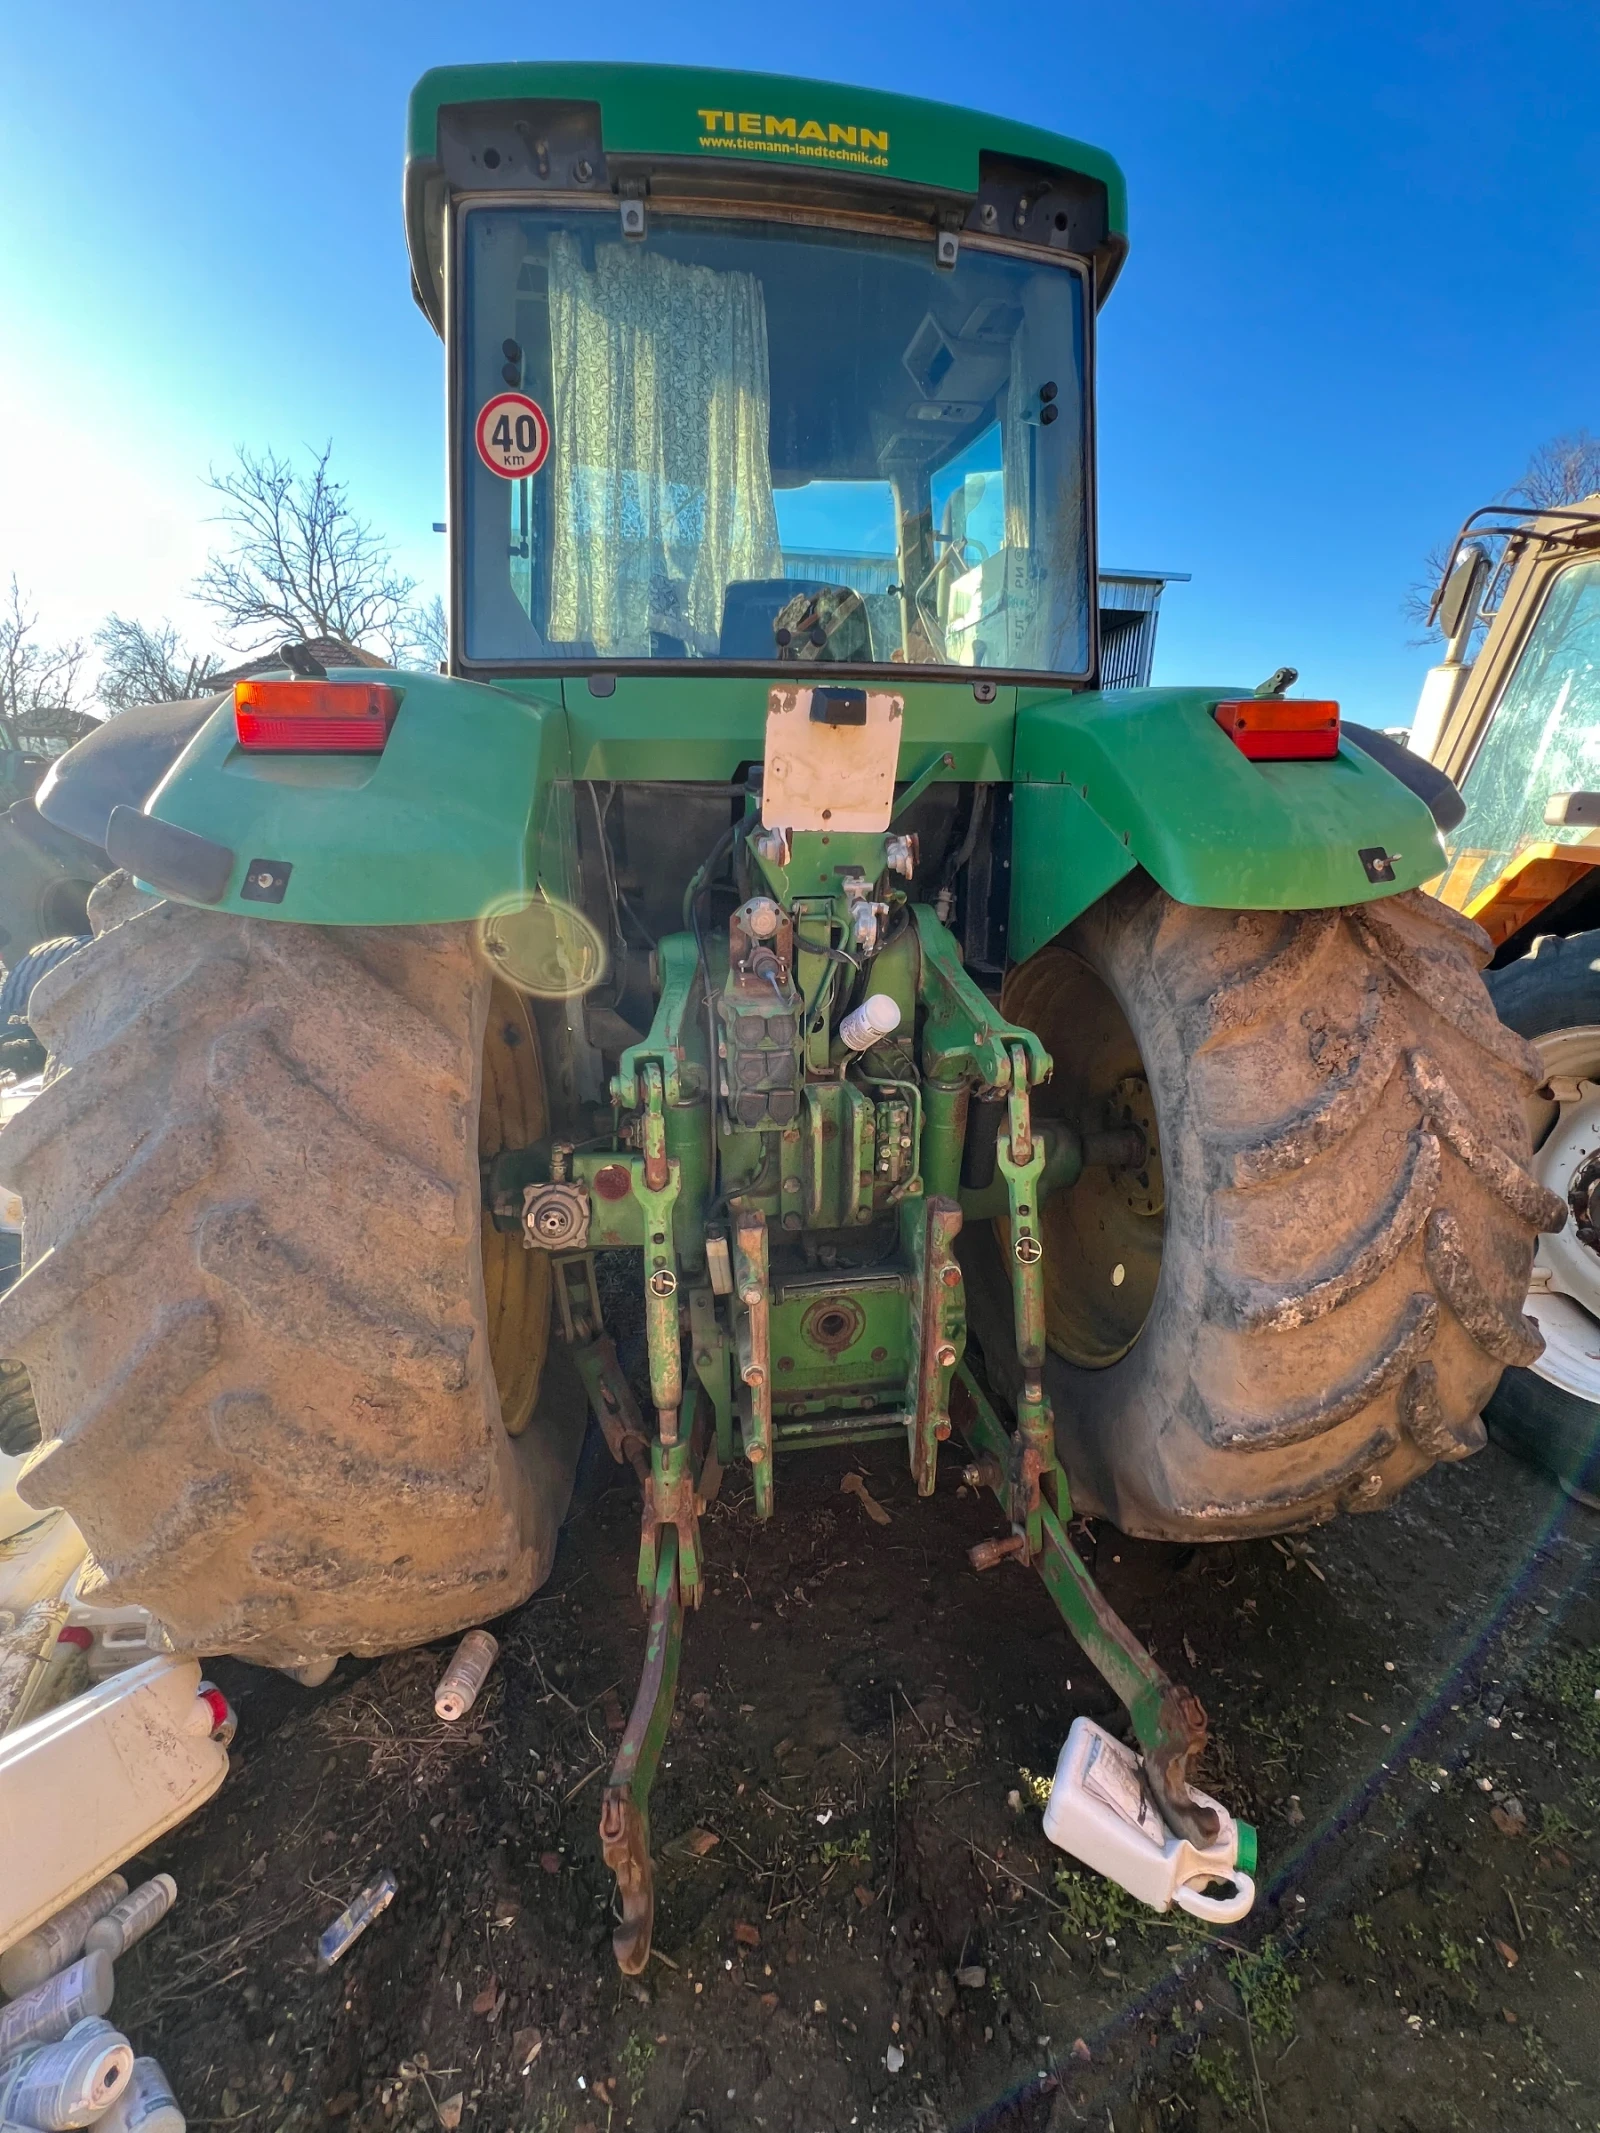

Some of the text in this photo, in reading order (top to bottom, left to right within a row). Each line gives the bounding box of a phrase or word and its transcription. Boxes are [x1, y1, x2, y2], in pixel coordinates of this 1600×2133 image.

[697, 109, 889, 151] TIEMANN
[698, 136, 889, 167] www.tiemann-landtechnik.de
[491, 414, 537, 453] 40
